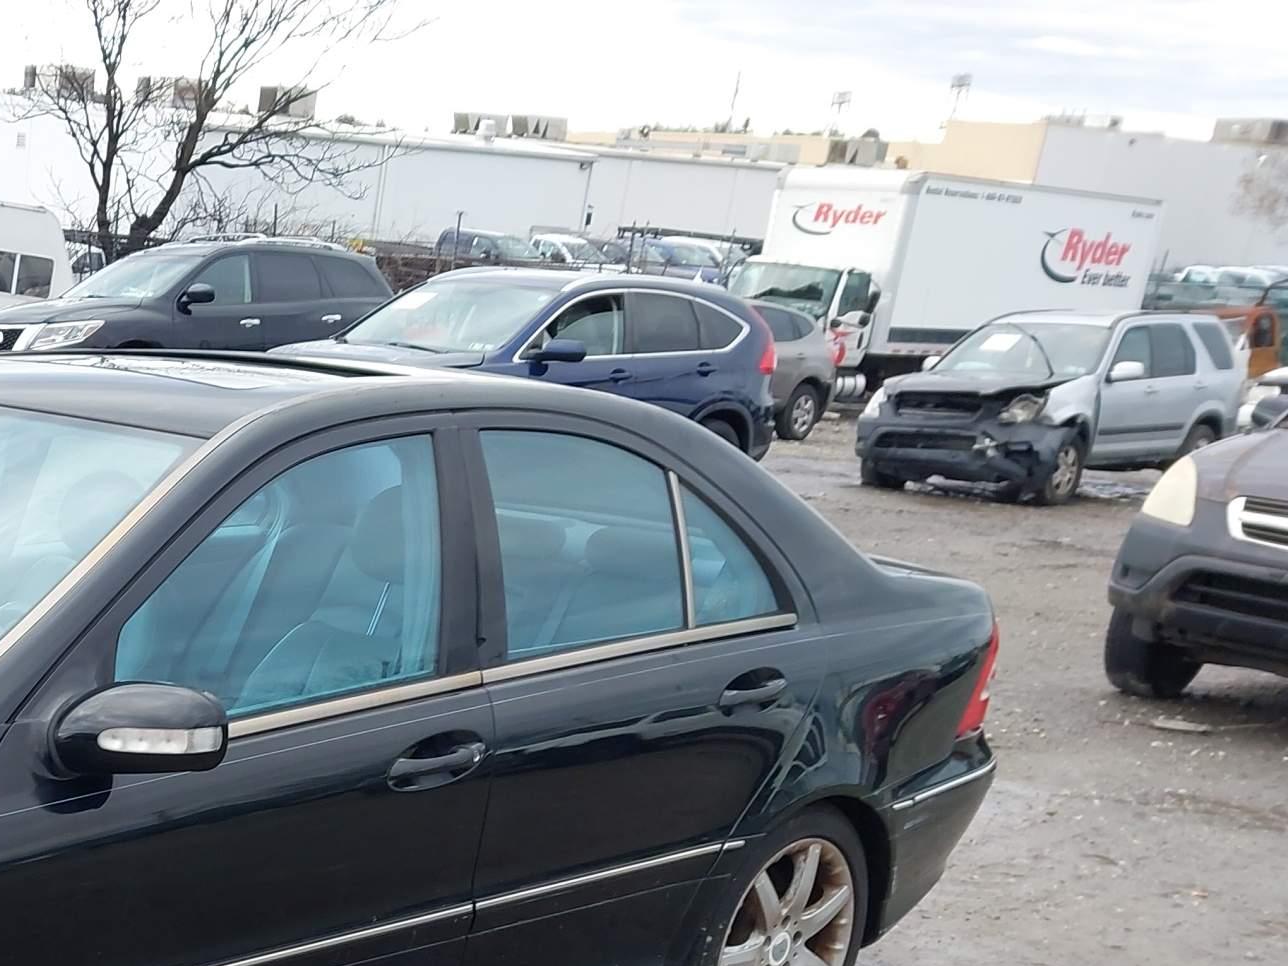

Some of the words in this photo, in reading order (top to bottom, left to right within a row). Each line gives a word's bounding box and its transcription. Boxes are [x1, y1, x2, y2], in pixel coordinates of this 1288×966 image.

[813, 203, 886, 228] Ryder
[1061, 227, 1131, 271] Ryder
[1081, 269, 1103, 286] Ever
